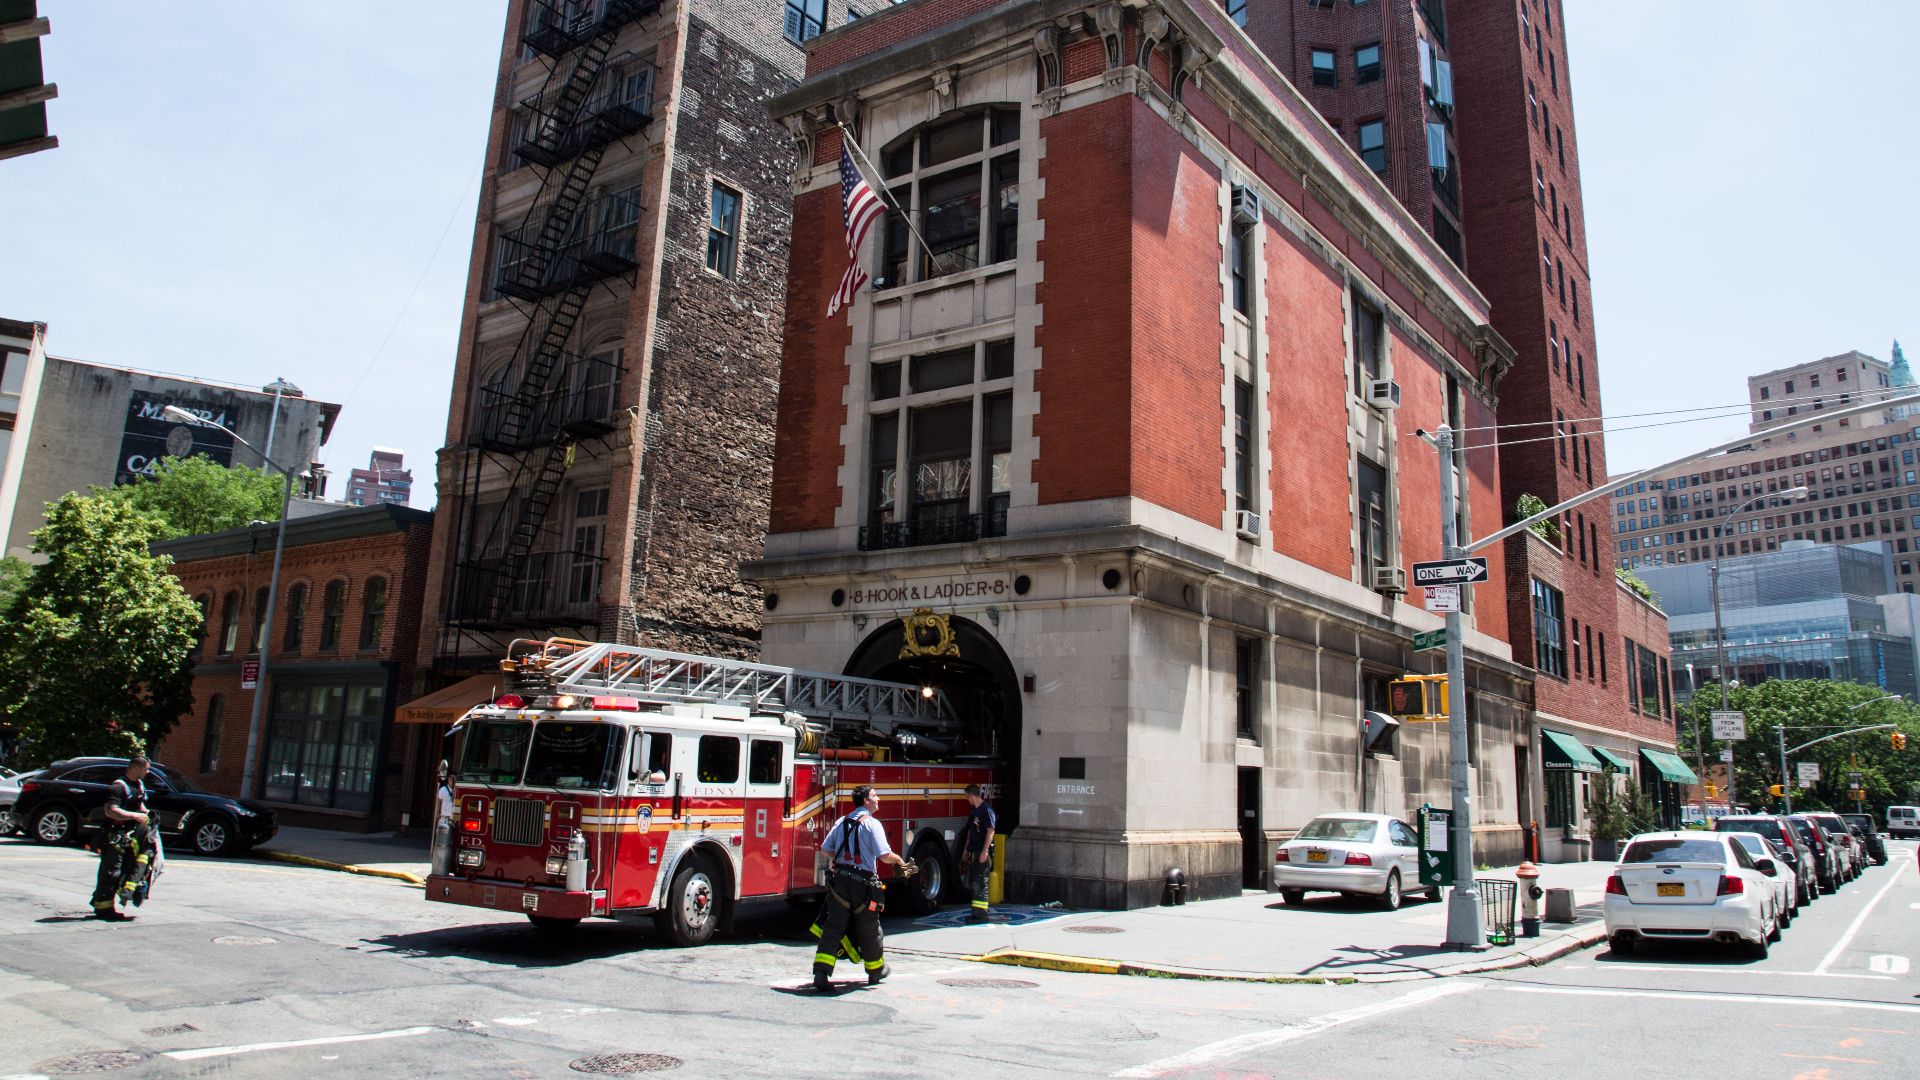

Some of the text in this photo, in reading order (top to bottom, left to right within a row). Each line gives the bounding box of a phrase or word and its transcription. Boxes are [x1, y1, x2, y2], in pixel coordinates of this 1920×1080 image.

[1420, 565, 1478, 579] ONE WAY
[868, 587, 908, 603] HOOK
[910, 587, 920, 600] &
[924, 581, 988, 599] LADDER
[1425, 588, 1435, 597] NO
[1057, 784, 1095, 795] ENTRANCE
[1691, 808, 1727, 816] CLUSS
